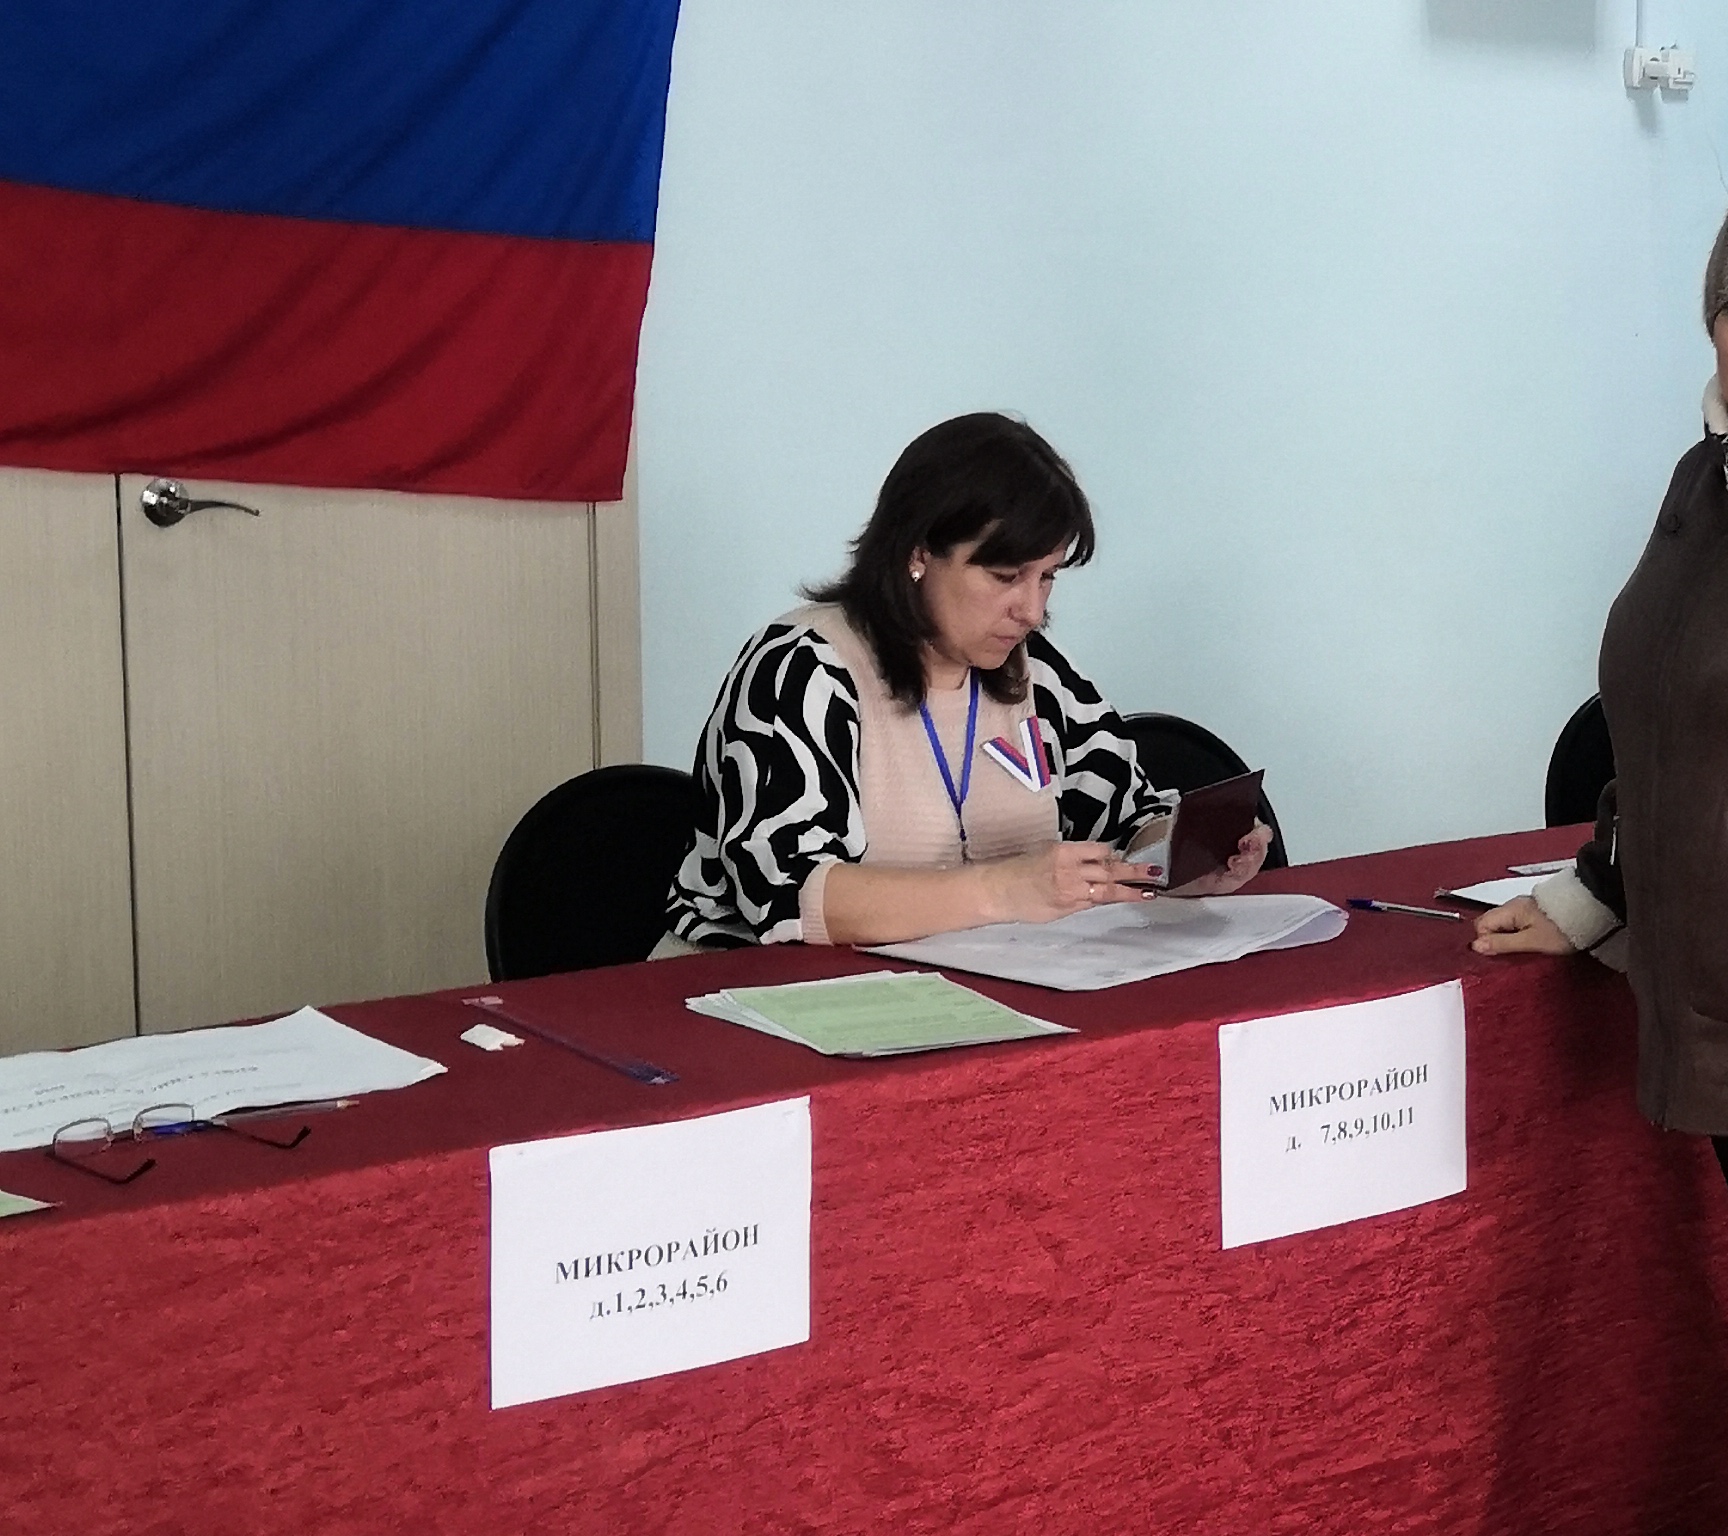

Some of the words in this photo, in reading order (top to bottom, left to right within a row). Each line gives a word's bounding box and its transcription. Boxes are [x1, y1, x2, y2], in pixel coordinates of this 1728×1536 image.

[1269, 1063, 1429, 1115] МИКРОРАЙОН
[1320, 1106, 1414, 1145] 7,8,9,10,11
[554, 1223, 760, 1284] МИКРОРАЙОН
[589, 1269, 729, 1320] д.1,2,3,4,5,6
